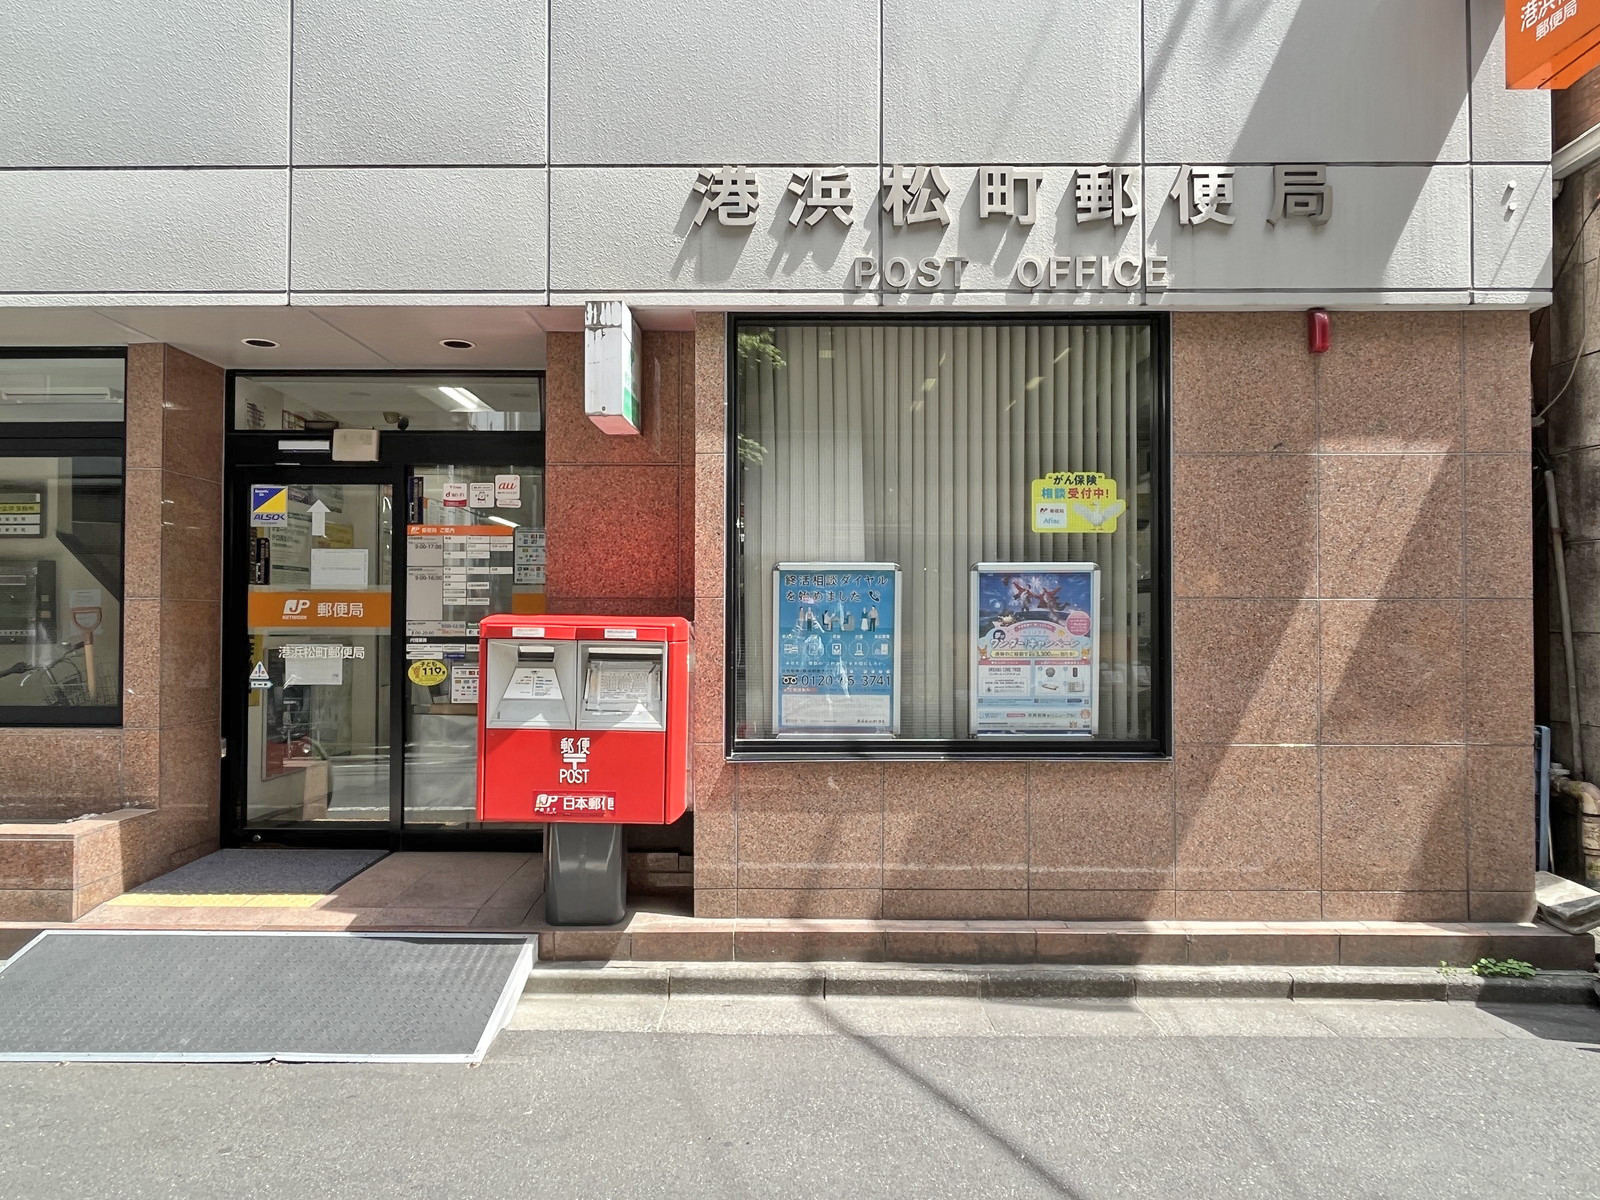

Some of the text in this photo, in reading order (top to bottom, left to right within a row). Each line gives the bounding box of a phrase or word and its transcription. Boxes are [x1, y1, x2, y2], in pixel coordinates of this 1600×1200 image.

[1535, 0, 1578, 42] 郵便局
[692, 163, 1334, 230] 港浜松町郵便局
[853, 256, 1171, 289] POST OFFICE
[498, 482, 518, 490] au
[1041, 487, 1109, 499] 相談受付中!
[253, 513, 285, 521] ALSOK
[784, 574, 888, 587] 終活相談ダイヤル
[785, 590, 862, 602] を始めました
[317, 602, 364, 618] 郵便局
[278, 645, 365, 660] 港浜松町郵便局
[560, 737, 591, 755] 郵便
[559, 768, 590, 784] POST
[563, 796, 615, 811] 日本郵便
